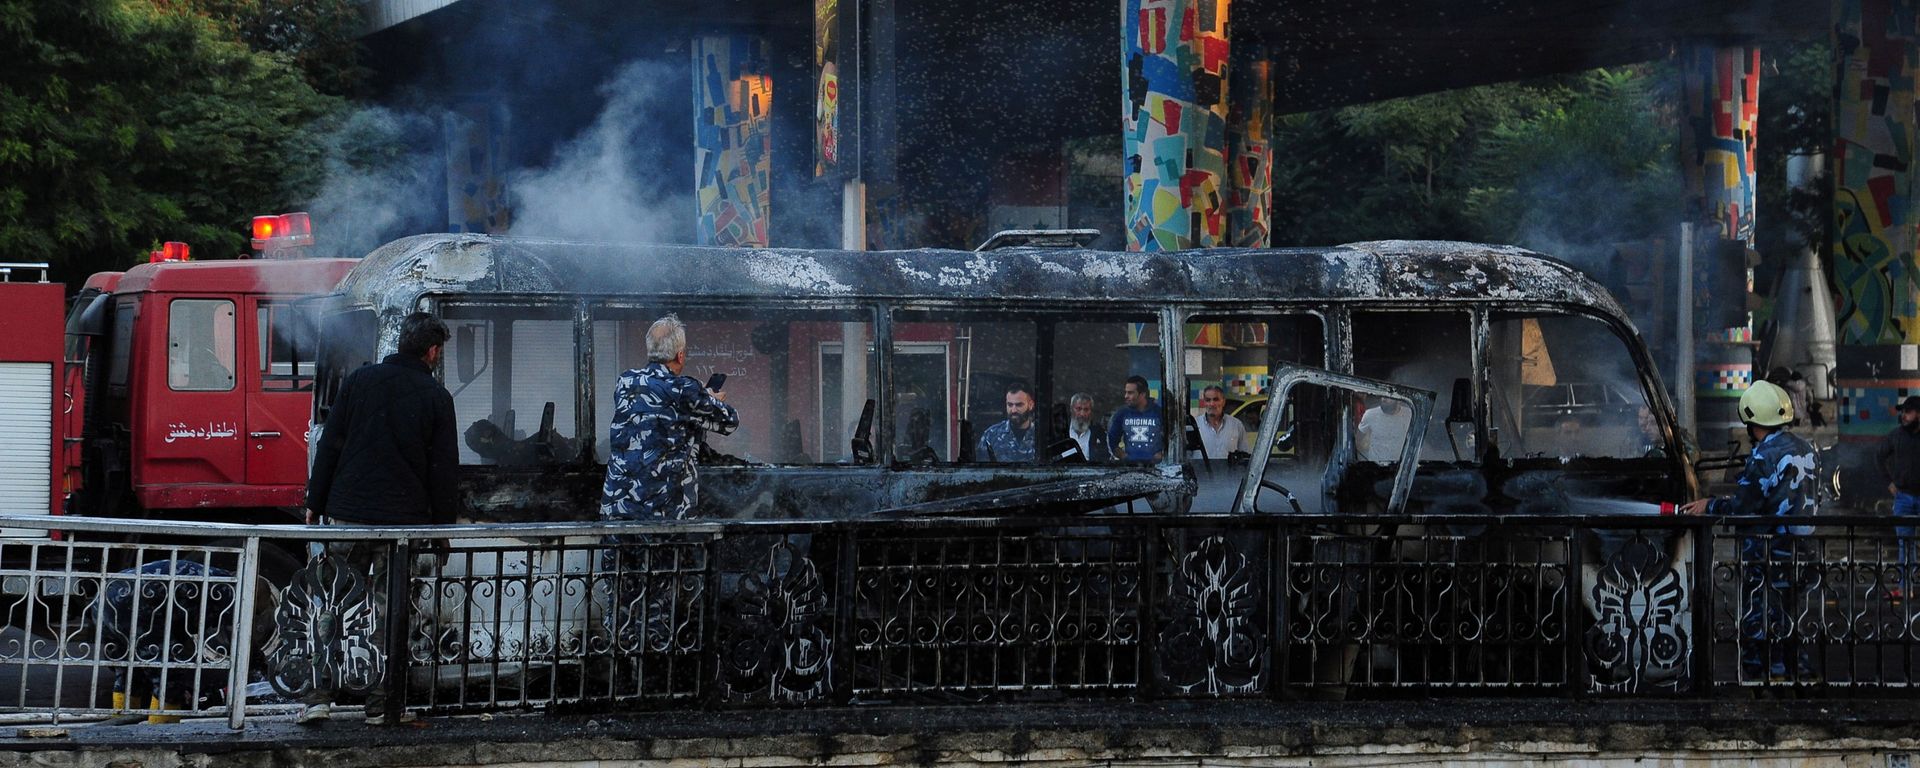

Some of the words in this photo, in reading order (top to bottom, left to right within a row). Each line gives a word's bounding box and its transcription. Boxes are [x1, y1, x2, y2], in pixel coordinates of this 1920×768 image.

[205, 421, 238, 440] إطفاء
[1124, 418, 1156, 426] ORIGINAL
[164, 421, 205, 443] دمشق
